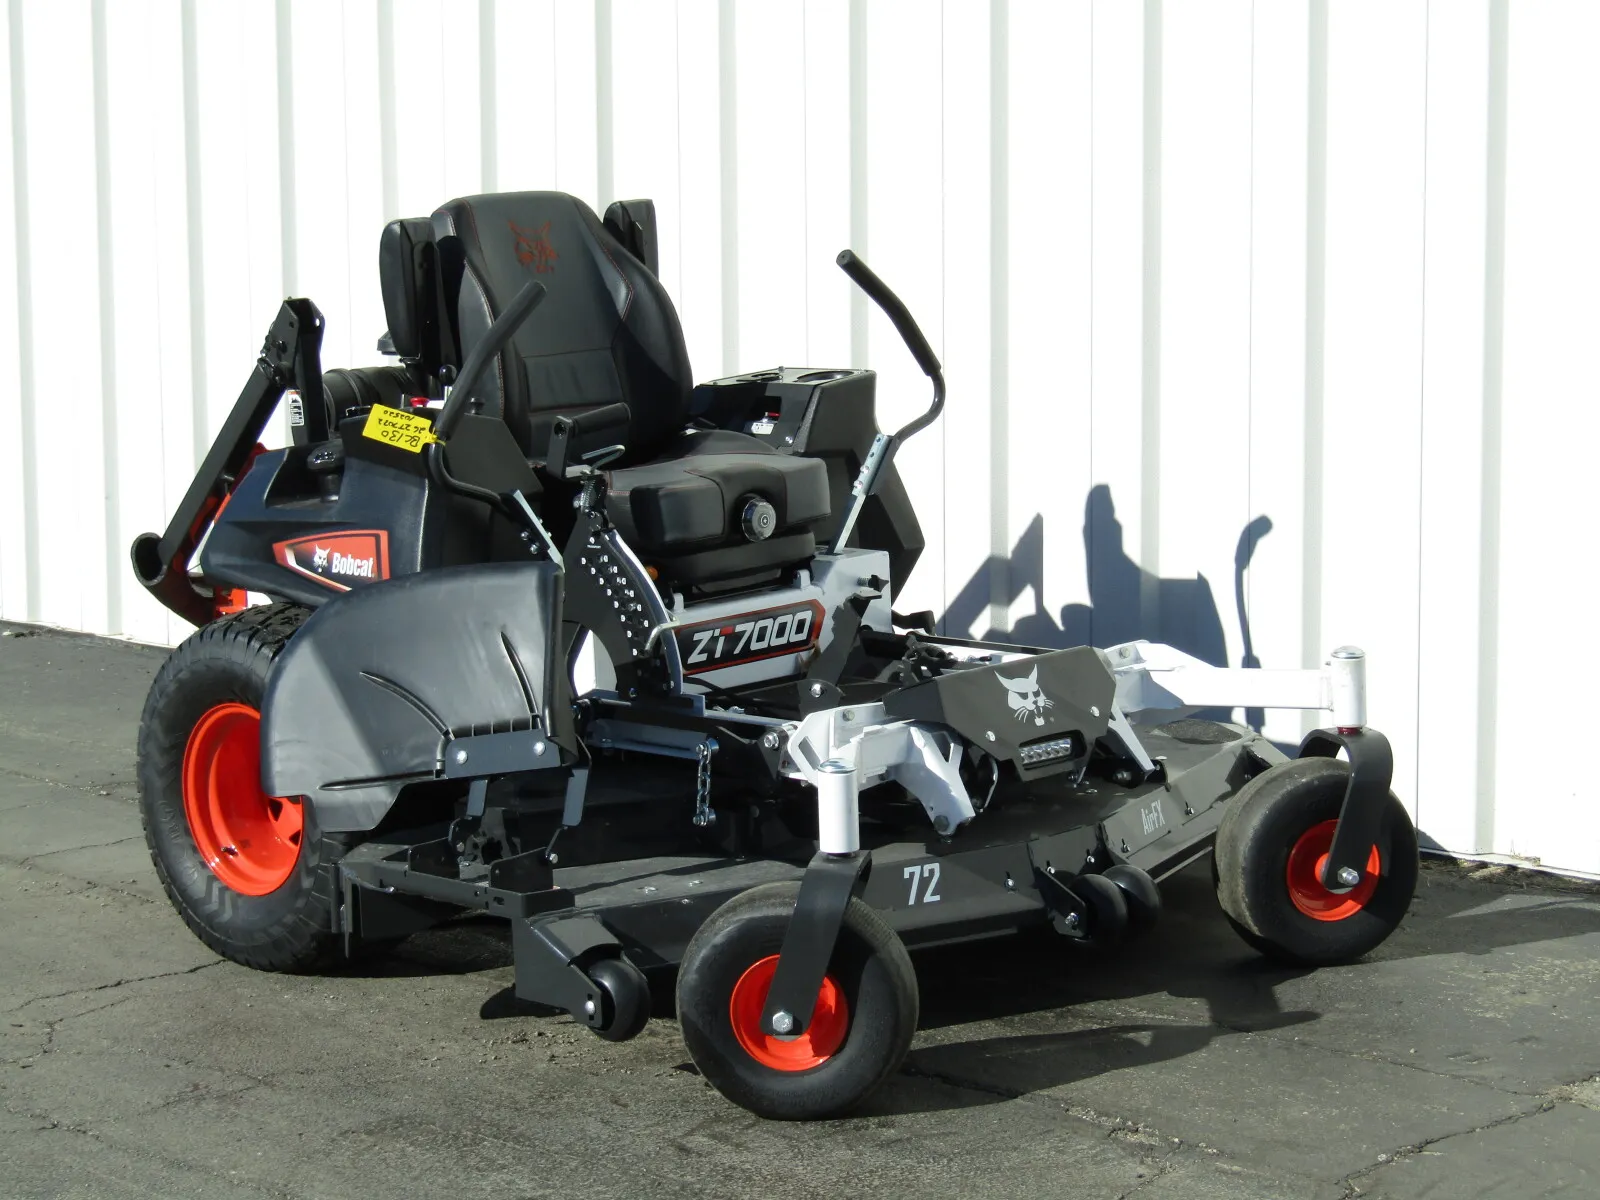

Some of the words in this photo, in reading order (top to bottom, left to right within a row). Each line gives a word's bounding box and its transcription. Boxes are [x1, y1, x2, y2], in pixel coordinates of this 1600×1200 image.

[332, 552, 374, 578] Bobcat
[1141, 800, 1165, 836] AirFX
[904, 863, 940, 905] 72
